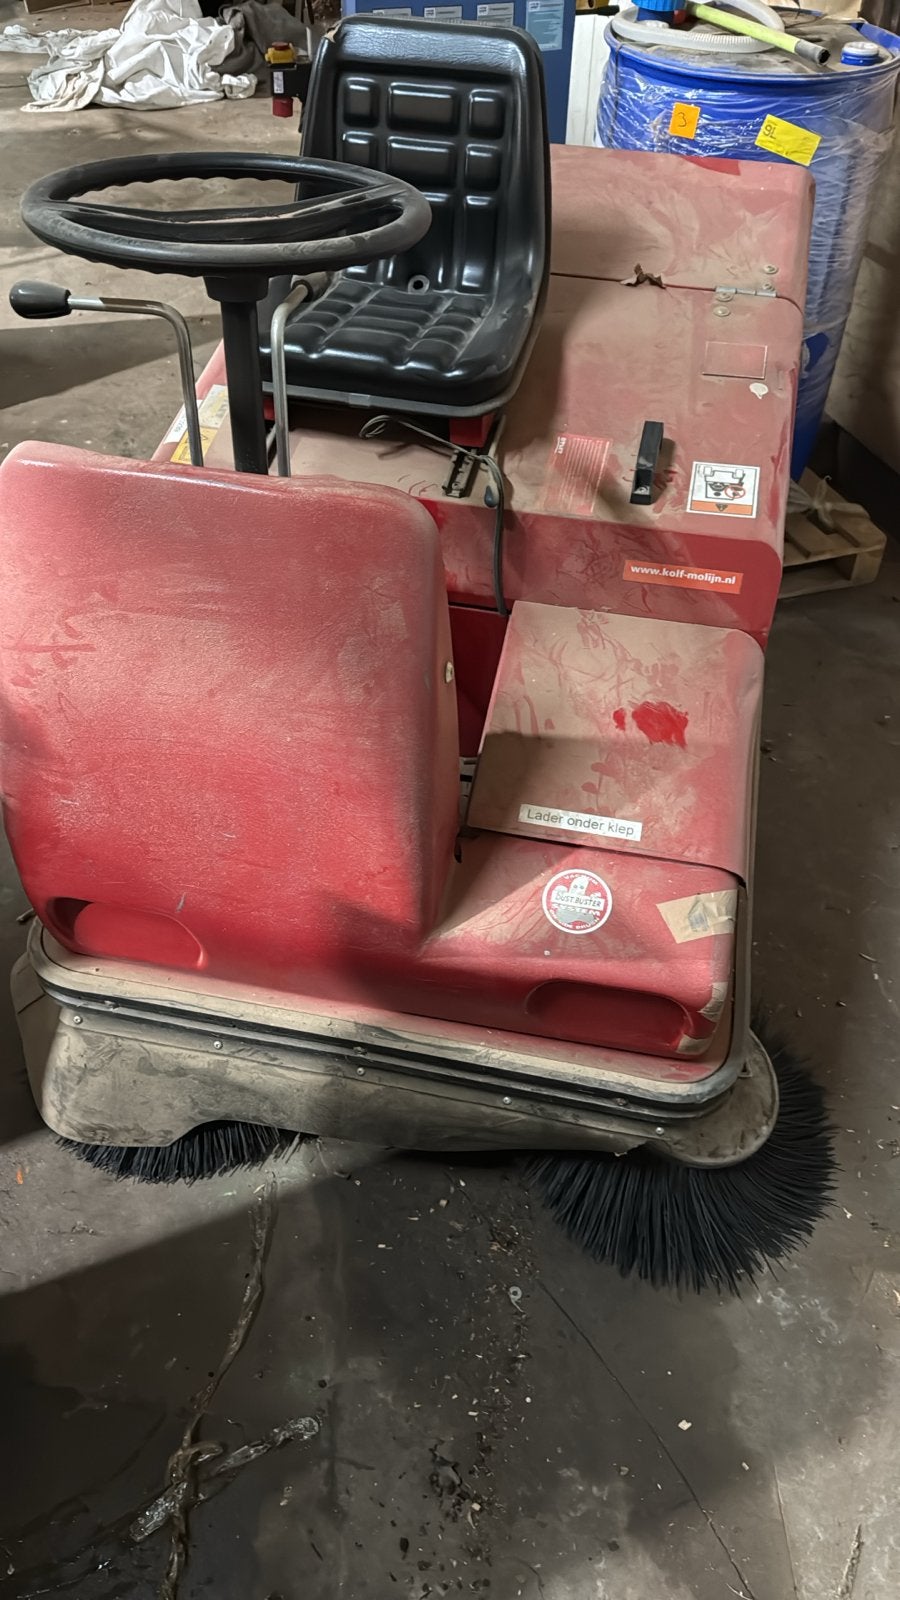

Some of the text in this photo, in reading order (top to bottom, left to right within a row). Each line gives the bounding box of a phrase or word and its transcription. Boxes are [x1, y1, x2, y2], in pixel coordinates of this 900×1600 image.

[677, 111, 688, 128] 3
[630, 565, 737, 585] www.kolf-molijn.nl
[527, 809, 634, 837] Lader onder klep
[575, 897, 602, 907] BUSTER
